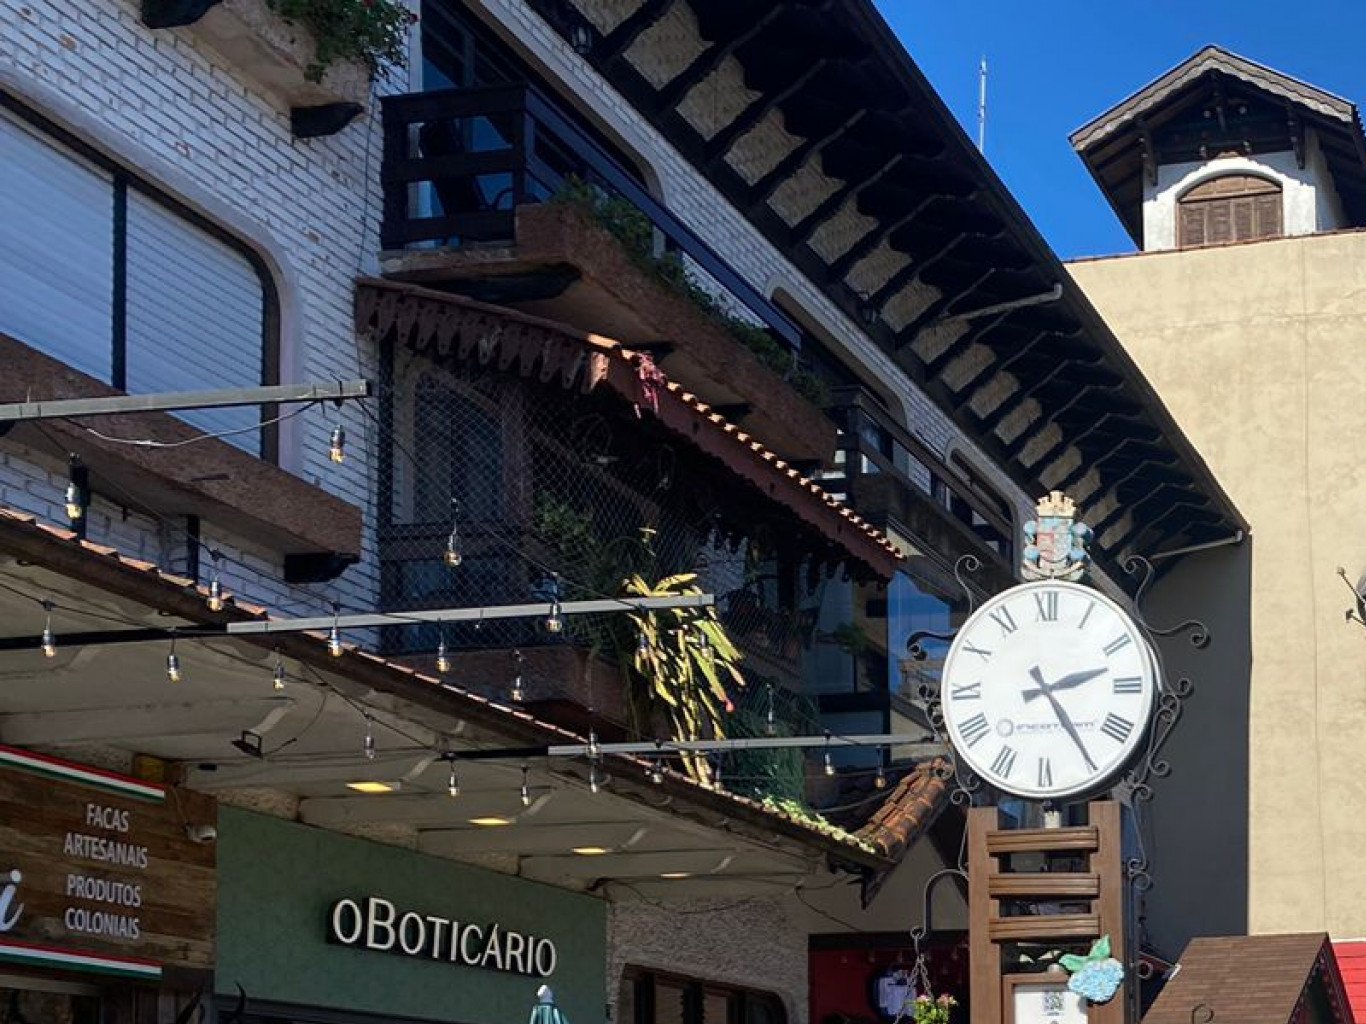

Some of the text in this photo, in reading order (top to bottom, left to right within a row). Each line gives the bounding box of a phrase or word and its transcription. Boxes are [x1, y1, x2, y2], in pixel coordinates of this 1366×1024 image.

[86, 803, 130, 832] FACAS
[63, 832, 149, 869] ARTESANAIS
[66, 873, 142, 908] PRODUTOS
[64, 907, 140, 940] COLONIAIS
